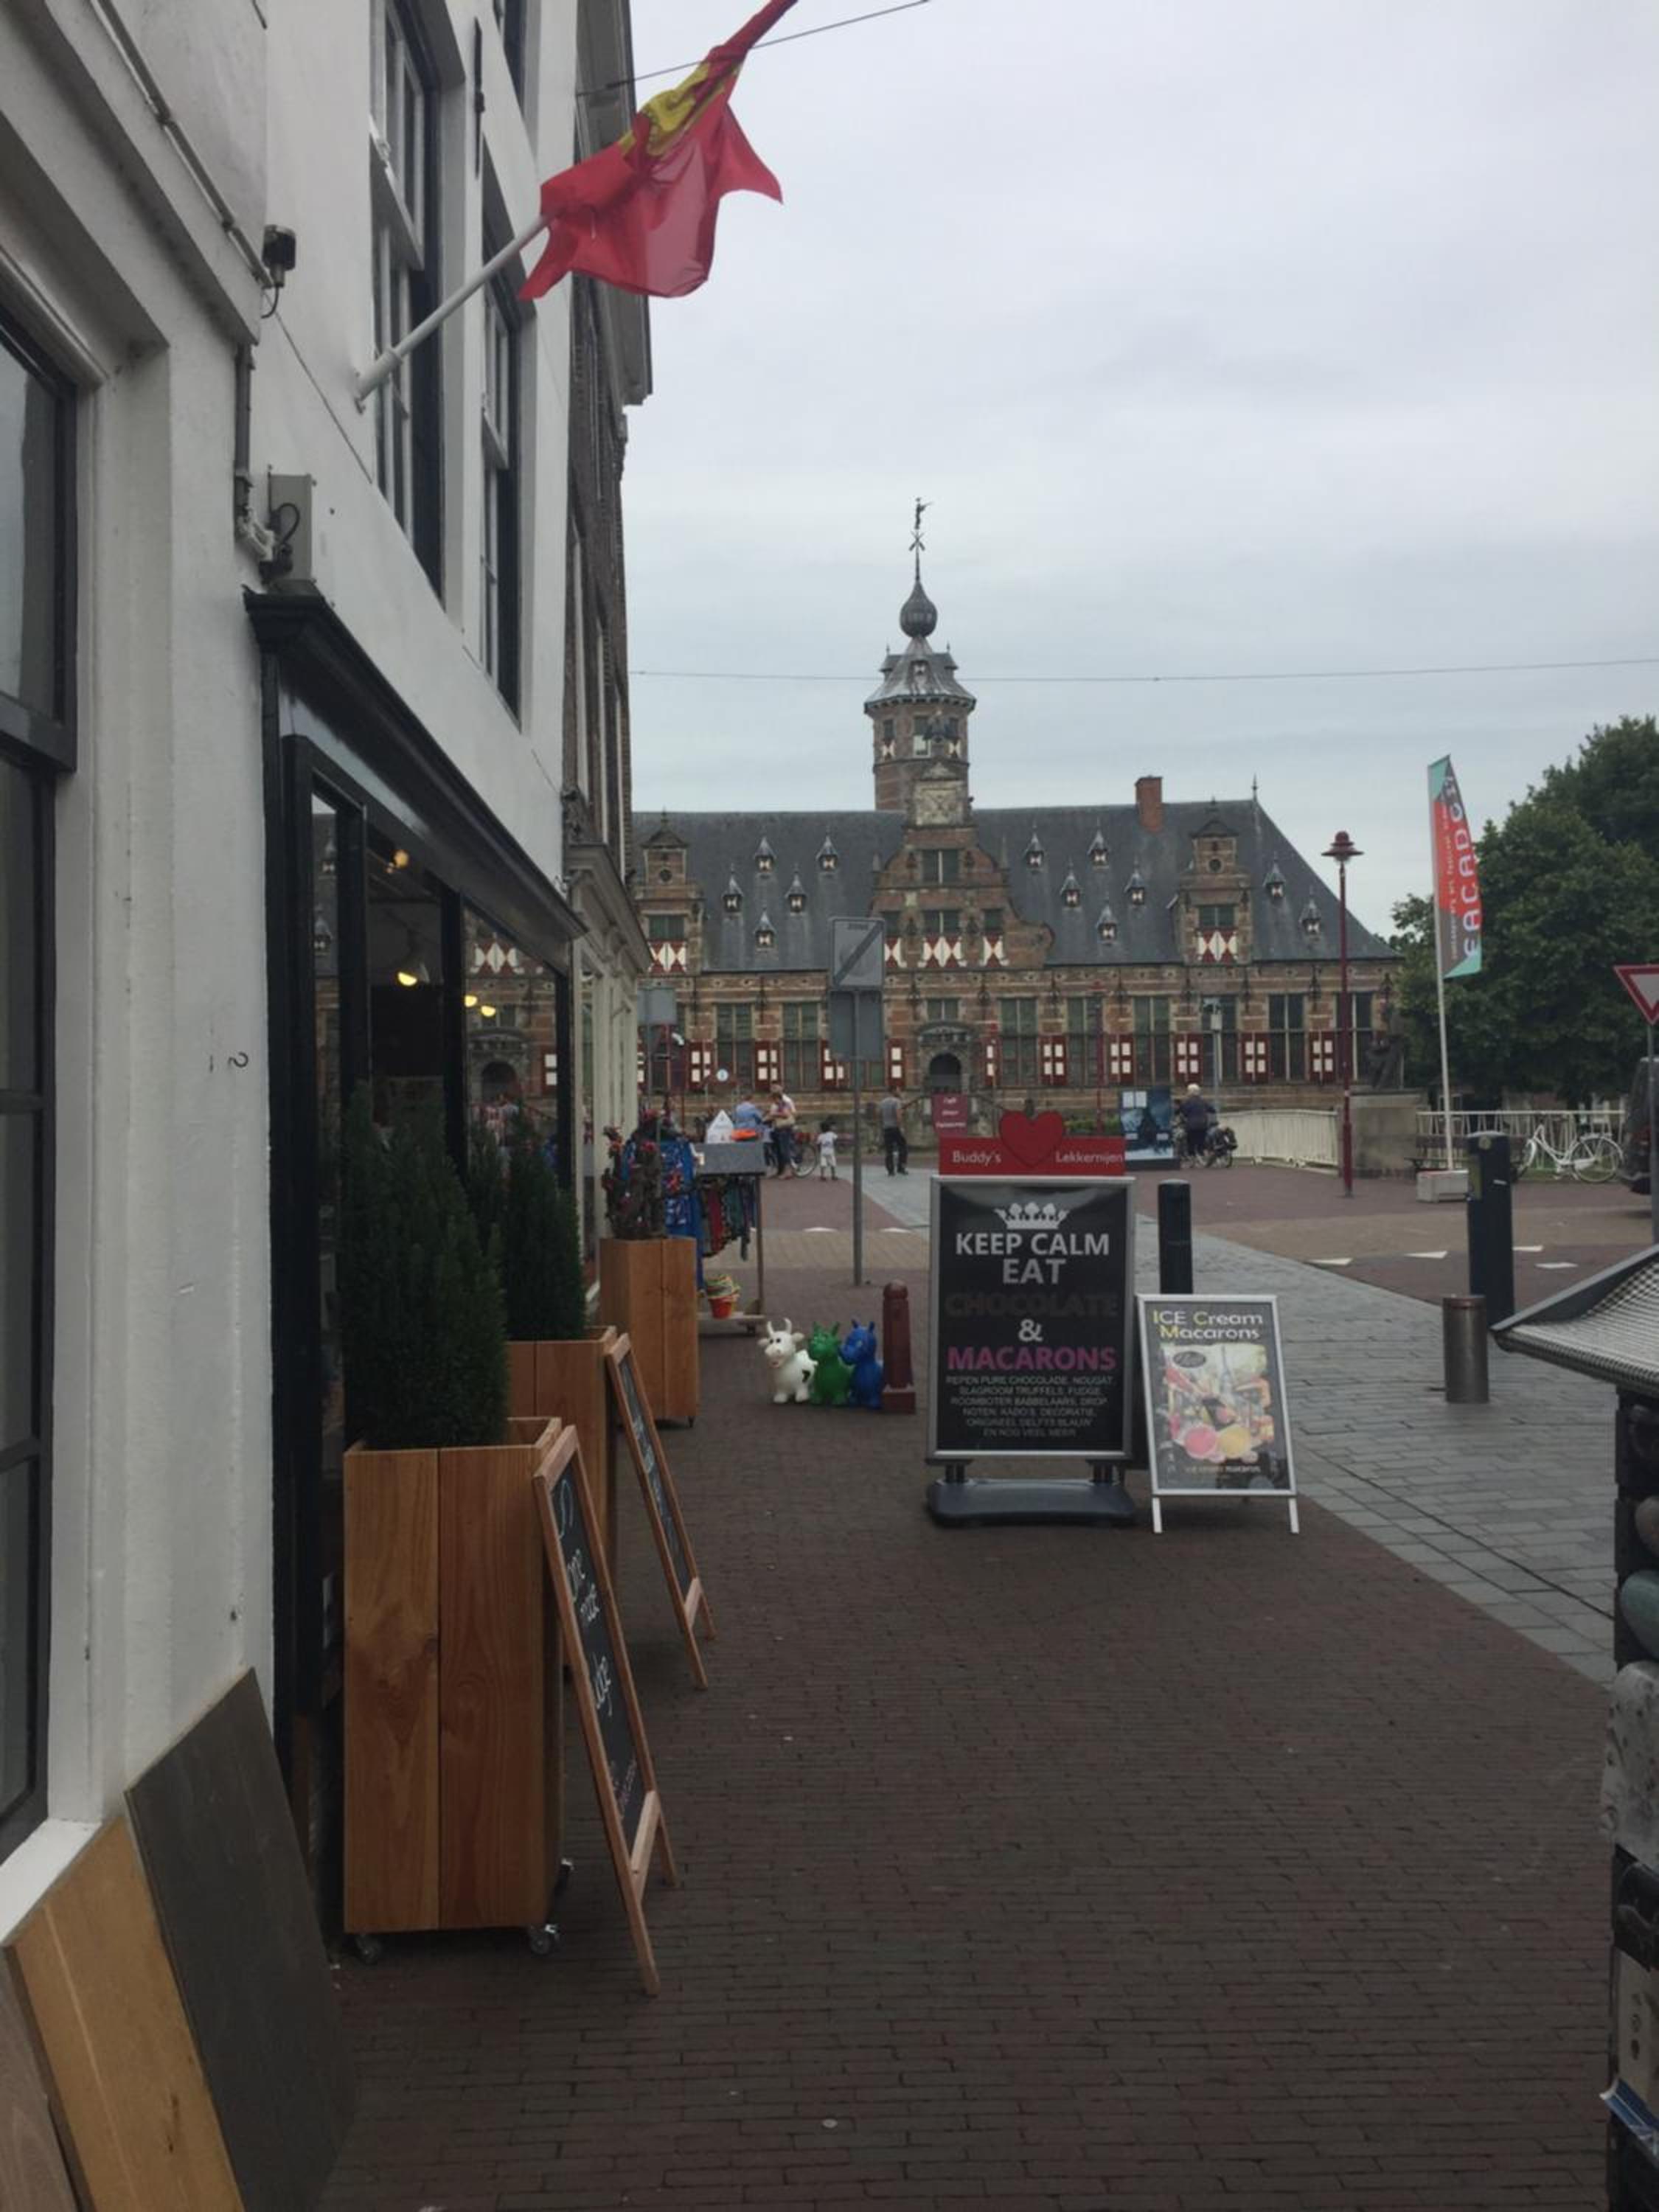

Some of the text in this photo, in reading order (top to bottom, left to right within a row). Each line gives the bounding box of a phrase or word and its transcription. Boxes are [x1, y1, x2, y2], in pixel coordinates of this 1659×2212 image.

[952, 1151, 1001, 1165] Buddy's
[956, 1233, 1110, 1255] KEEP CALM
[1003, 1258, 1066, 1284] EAT
[945, 1292, 1119, 1317] CHOCOLATE
[1153, 1310, 1263, 1325] ICE Cream
[1018, 1318, 1043, 1342] &
[1159, 1325, 1260, 1340] Macarons
[947, 1345, 1117, 1370] MACARONS
